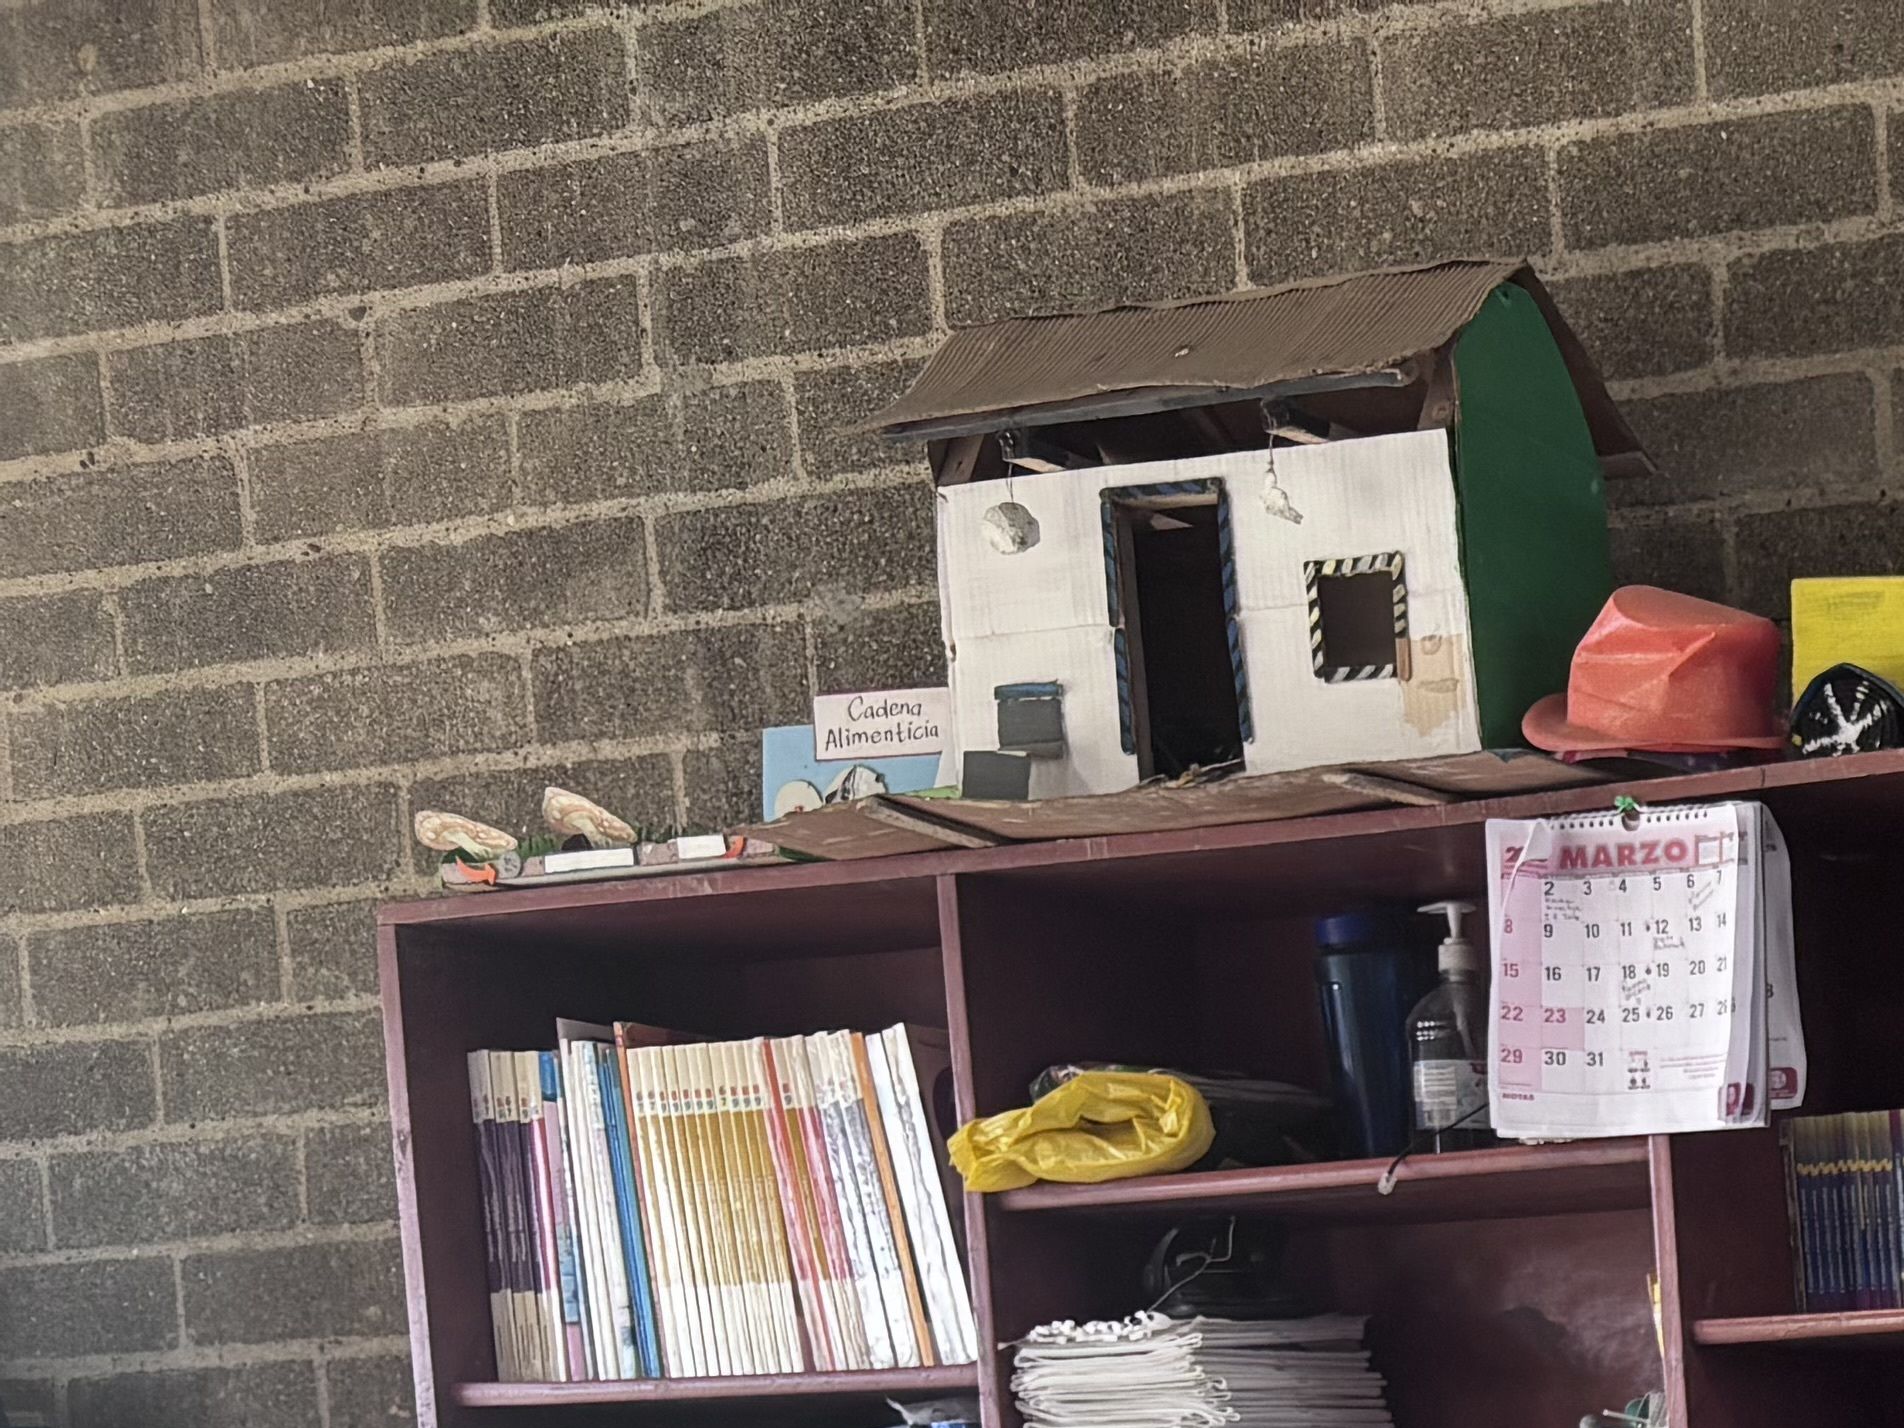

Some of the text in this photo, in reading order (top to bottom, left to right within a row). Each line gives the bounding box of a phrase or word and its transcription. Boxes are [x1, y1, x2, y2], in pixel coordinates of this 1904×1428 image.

[848, 695, 922, 722] Cadena
[825, 720, 939, 751] Alimenticia
[1559, 838, 1688, 870] MARZO
[1544, 870, 1722, 896] 2 3 4 5 6 7
[1504, 913, 1727, 938] 8 9 10 11 12 13 14
[1503, 957, 1727, 982] 15 16 17 18 19 20 21
[1500, 1006, 1523, 1022] 22
[1544, 1008, 1566, 1023] 23
[1586, 1009, 1606, 1025] 24
[1622, 1008, 1640, 1023] 25
[1656, 1006, 1673, 1020] 26
[1689, 1003, 1705, 1019] 27
[1500, 1049, 1604, 1067] 29 30 31
